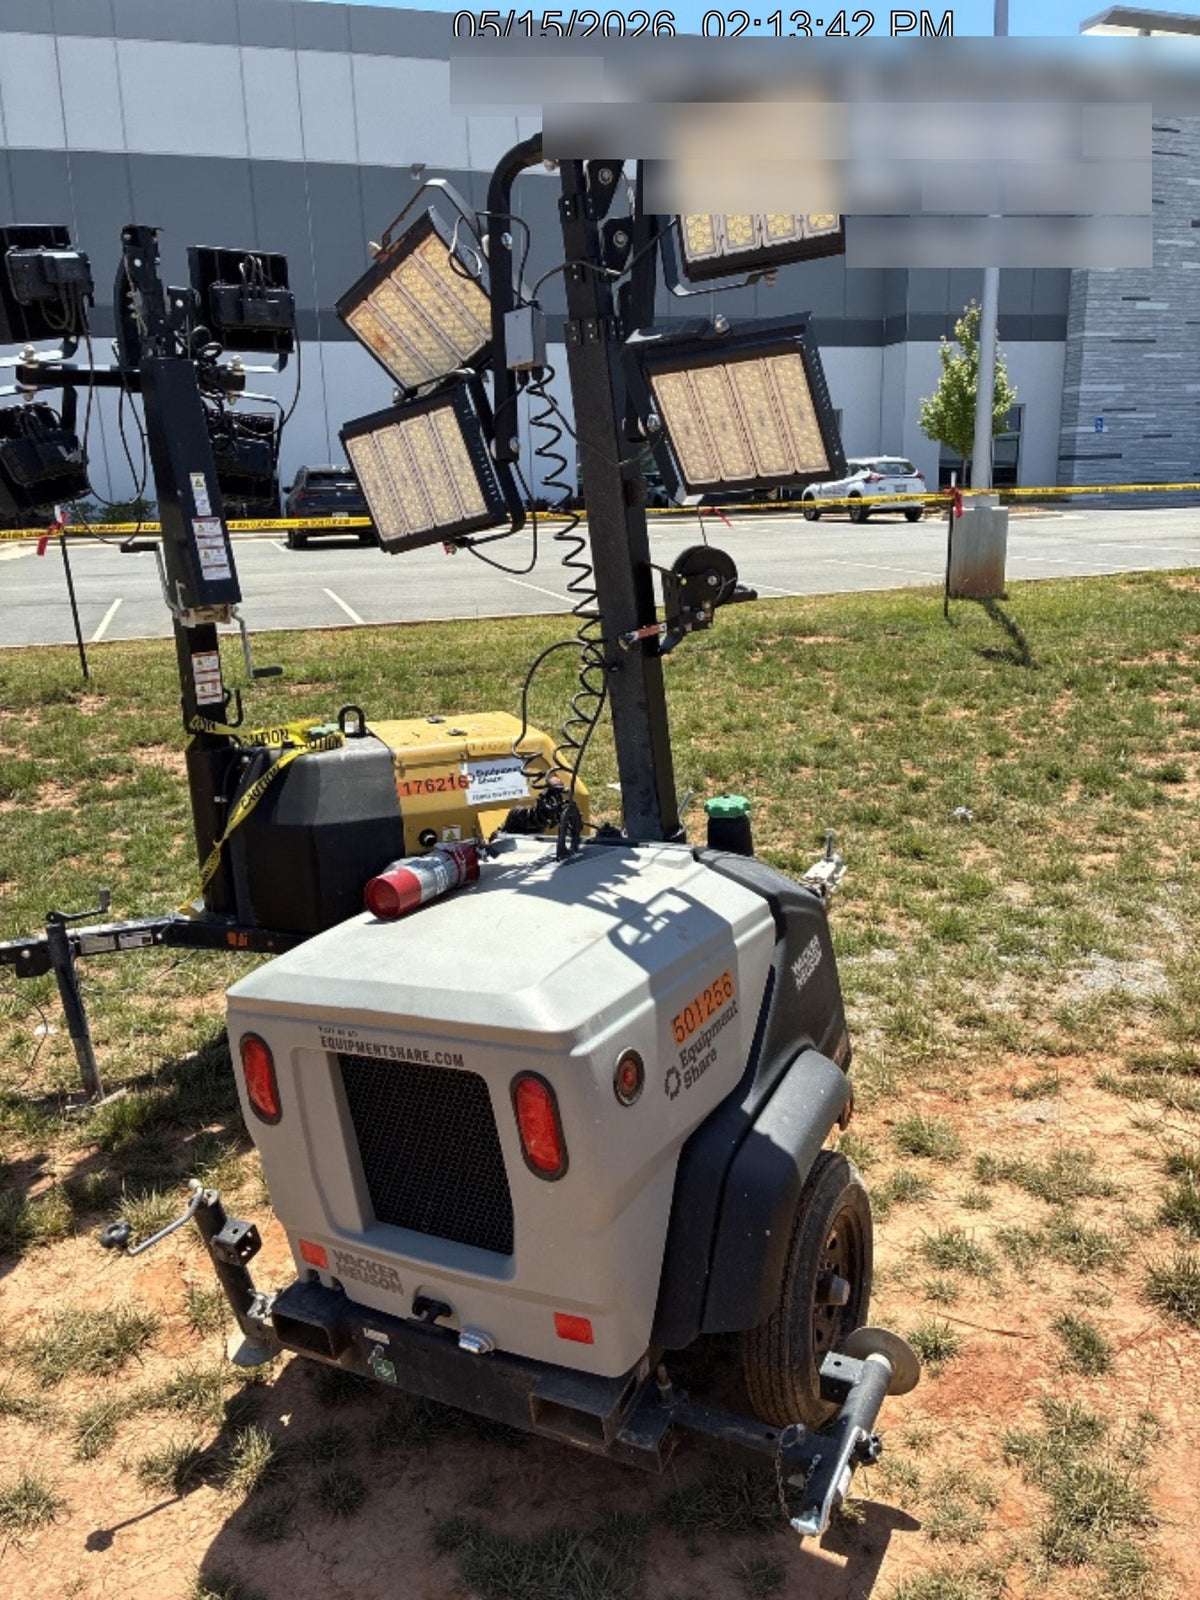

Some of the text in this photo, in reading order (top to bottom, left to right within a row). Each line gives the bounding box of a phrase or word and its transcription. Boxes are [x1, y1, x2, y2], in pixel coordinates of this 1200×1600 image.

[402, 774, 469, 796] 176216
[672, 972, 733, 1044] 501256
[320, 1035, 465, 1068] EQUIPMENTSHARE.COM
[678, 1000, 739, 1069] Equipment
[683, 1048, 718, 1090] Share
[332, 1249, 401, 1283] WACKER
[335, 1261, 404, 1296] NEUSON
